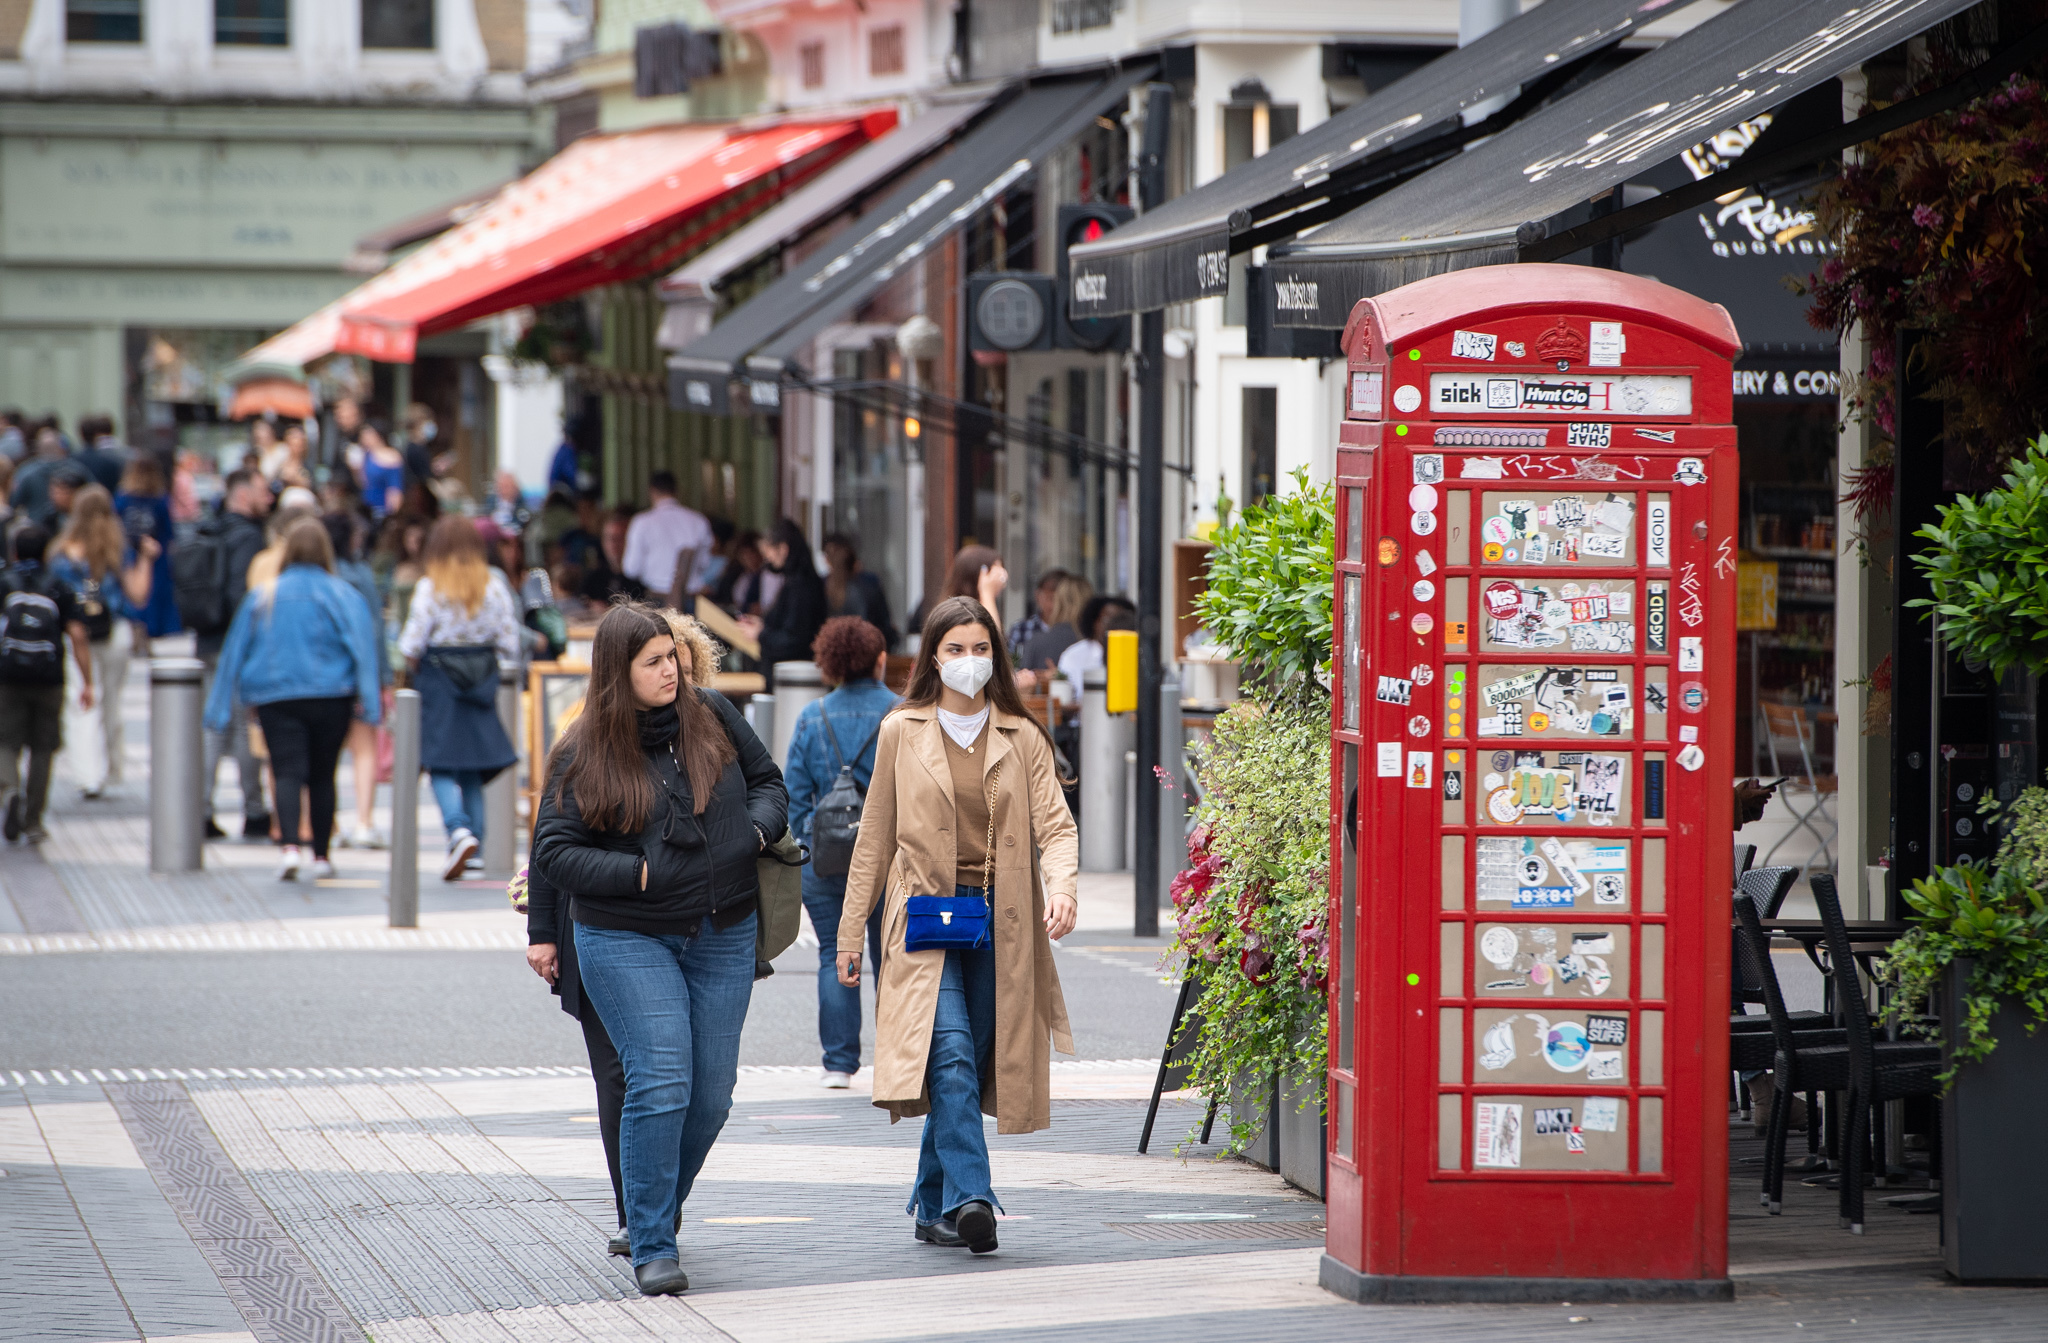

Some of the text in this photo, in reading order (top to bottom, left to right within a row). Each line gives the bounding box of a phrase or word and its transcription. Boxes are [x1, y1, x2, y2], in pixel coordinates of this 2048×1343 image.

[1441, 382, 1482, 403] sick
[1772, 369, 1789, 396] &
[1570, 423, 1609, 434] CHAF
[1578, 792, 1616, 812] EVIL
